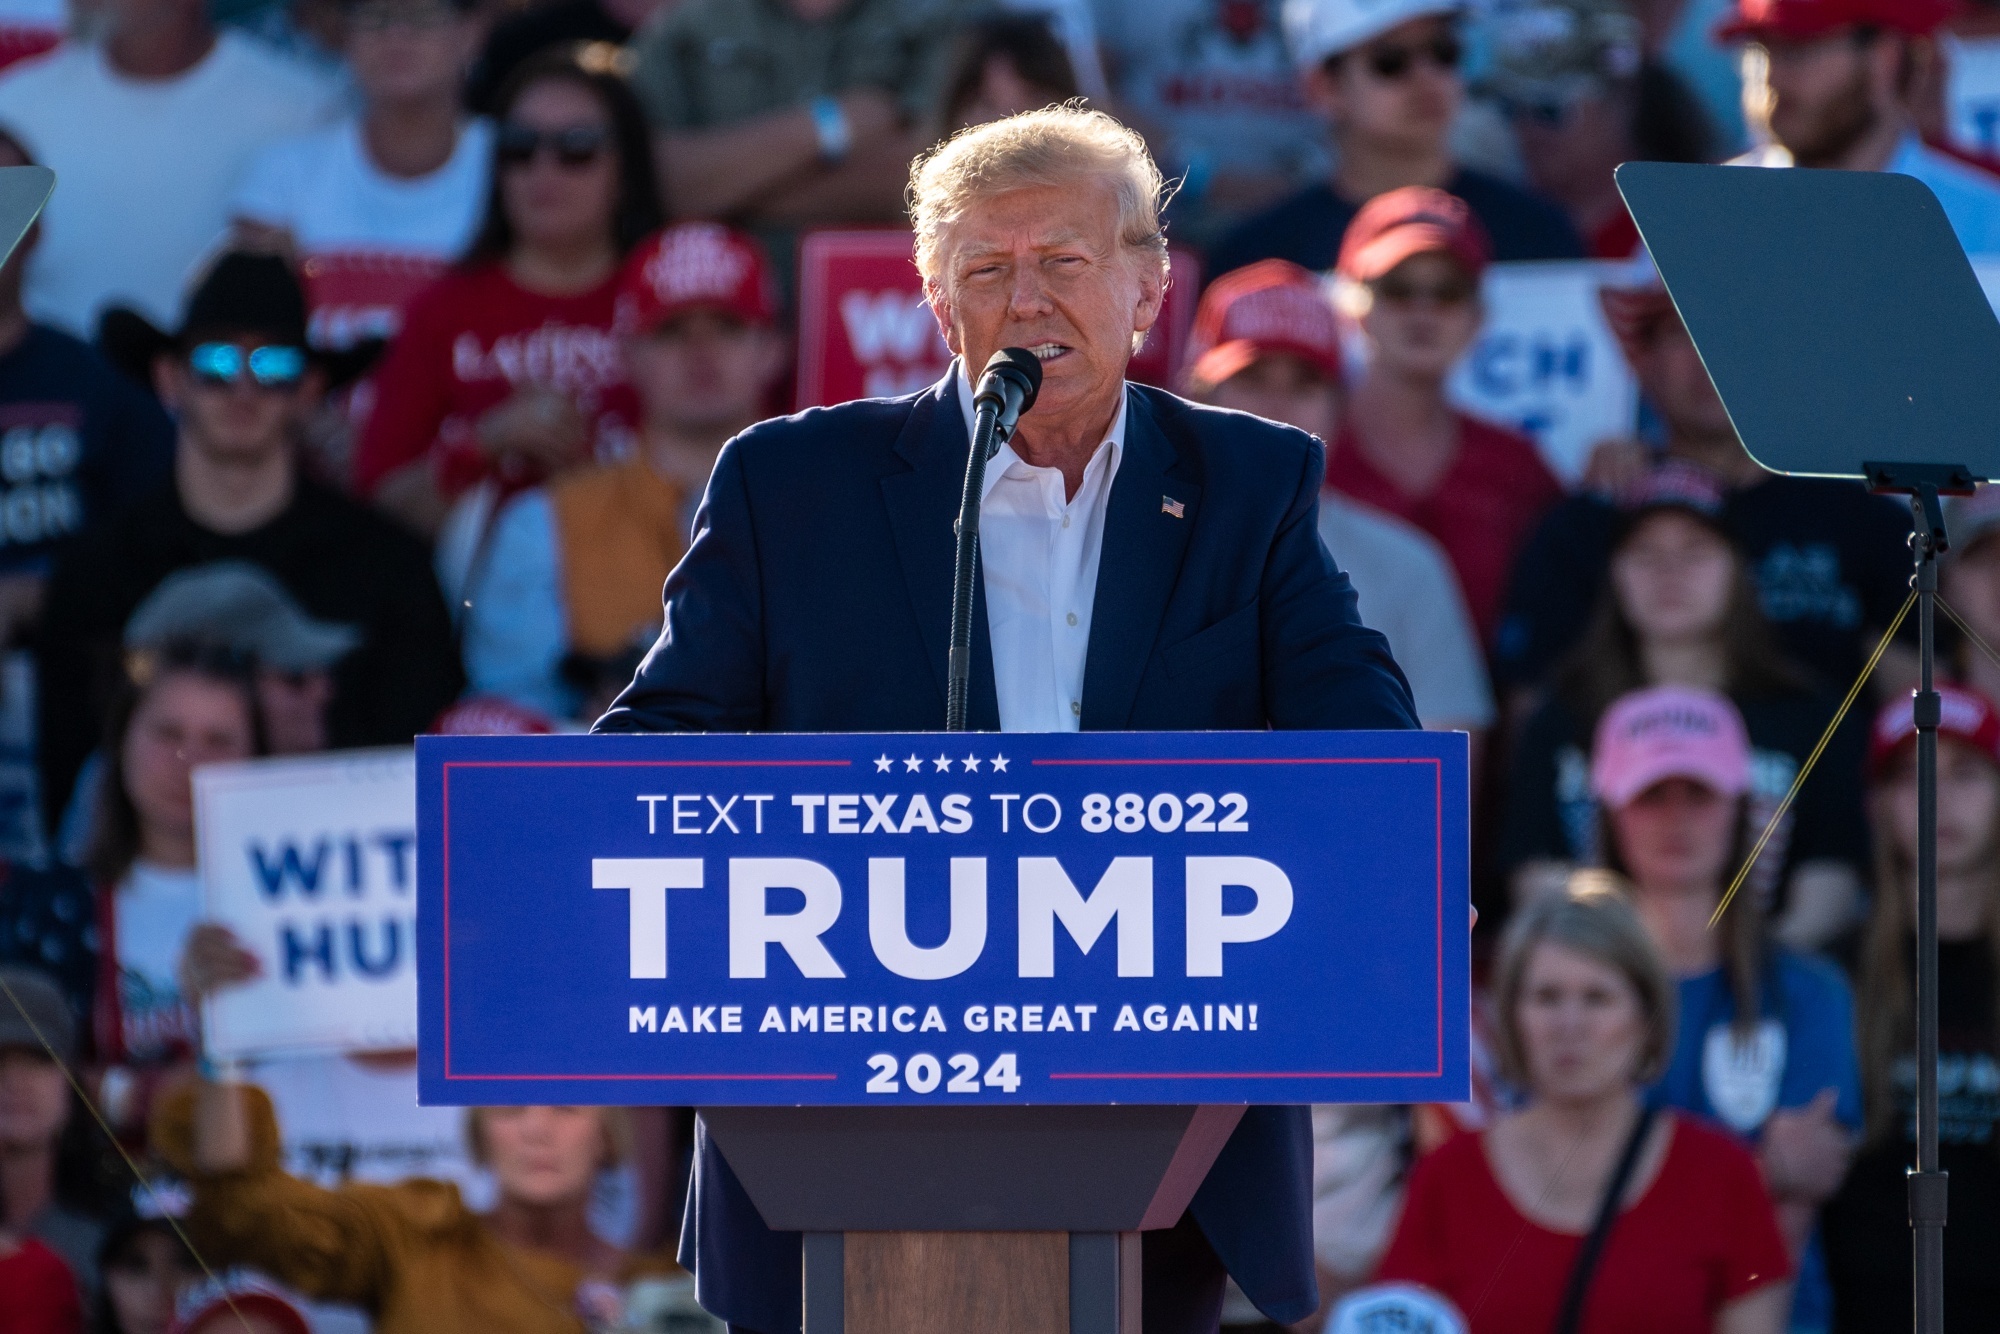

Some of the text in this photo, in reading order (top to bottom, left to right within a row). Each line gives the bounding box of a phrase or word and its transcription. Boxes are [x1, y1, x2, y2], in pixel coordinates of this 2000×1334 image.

[637, 793, 1249, 834] TEXT TEXAS TO 88022
[245, 830, 416, 903] WIT
[592, 856, 1294, 980] TRUMP
[629, 1004, 1259, 1033] MAKE AMERICA GREAT AGAIN!
[866, 1053, 1022, 1093] 2024
